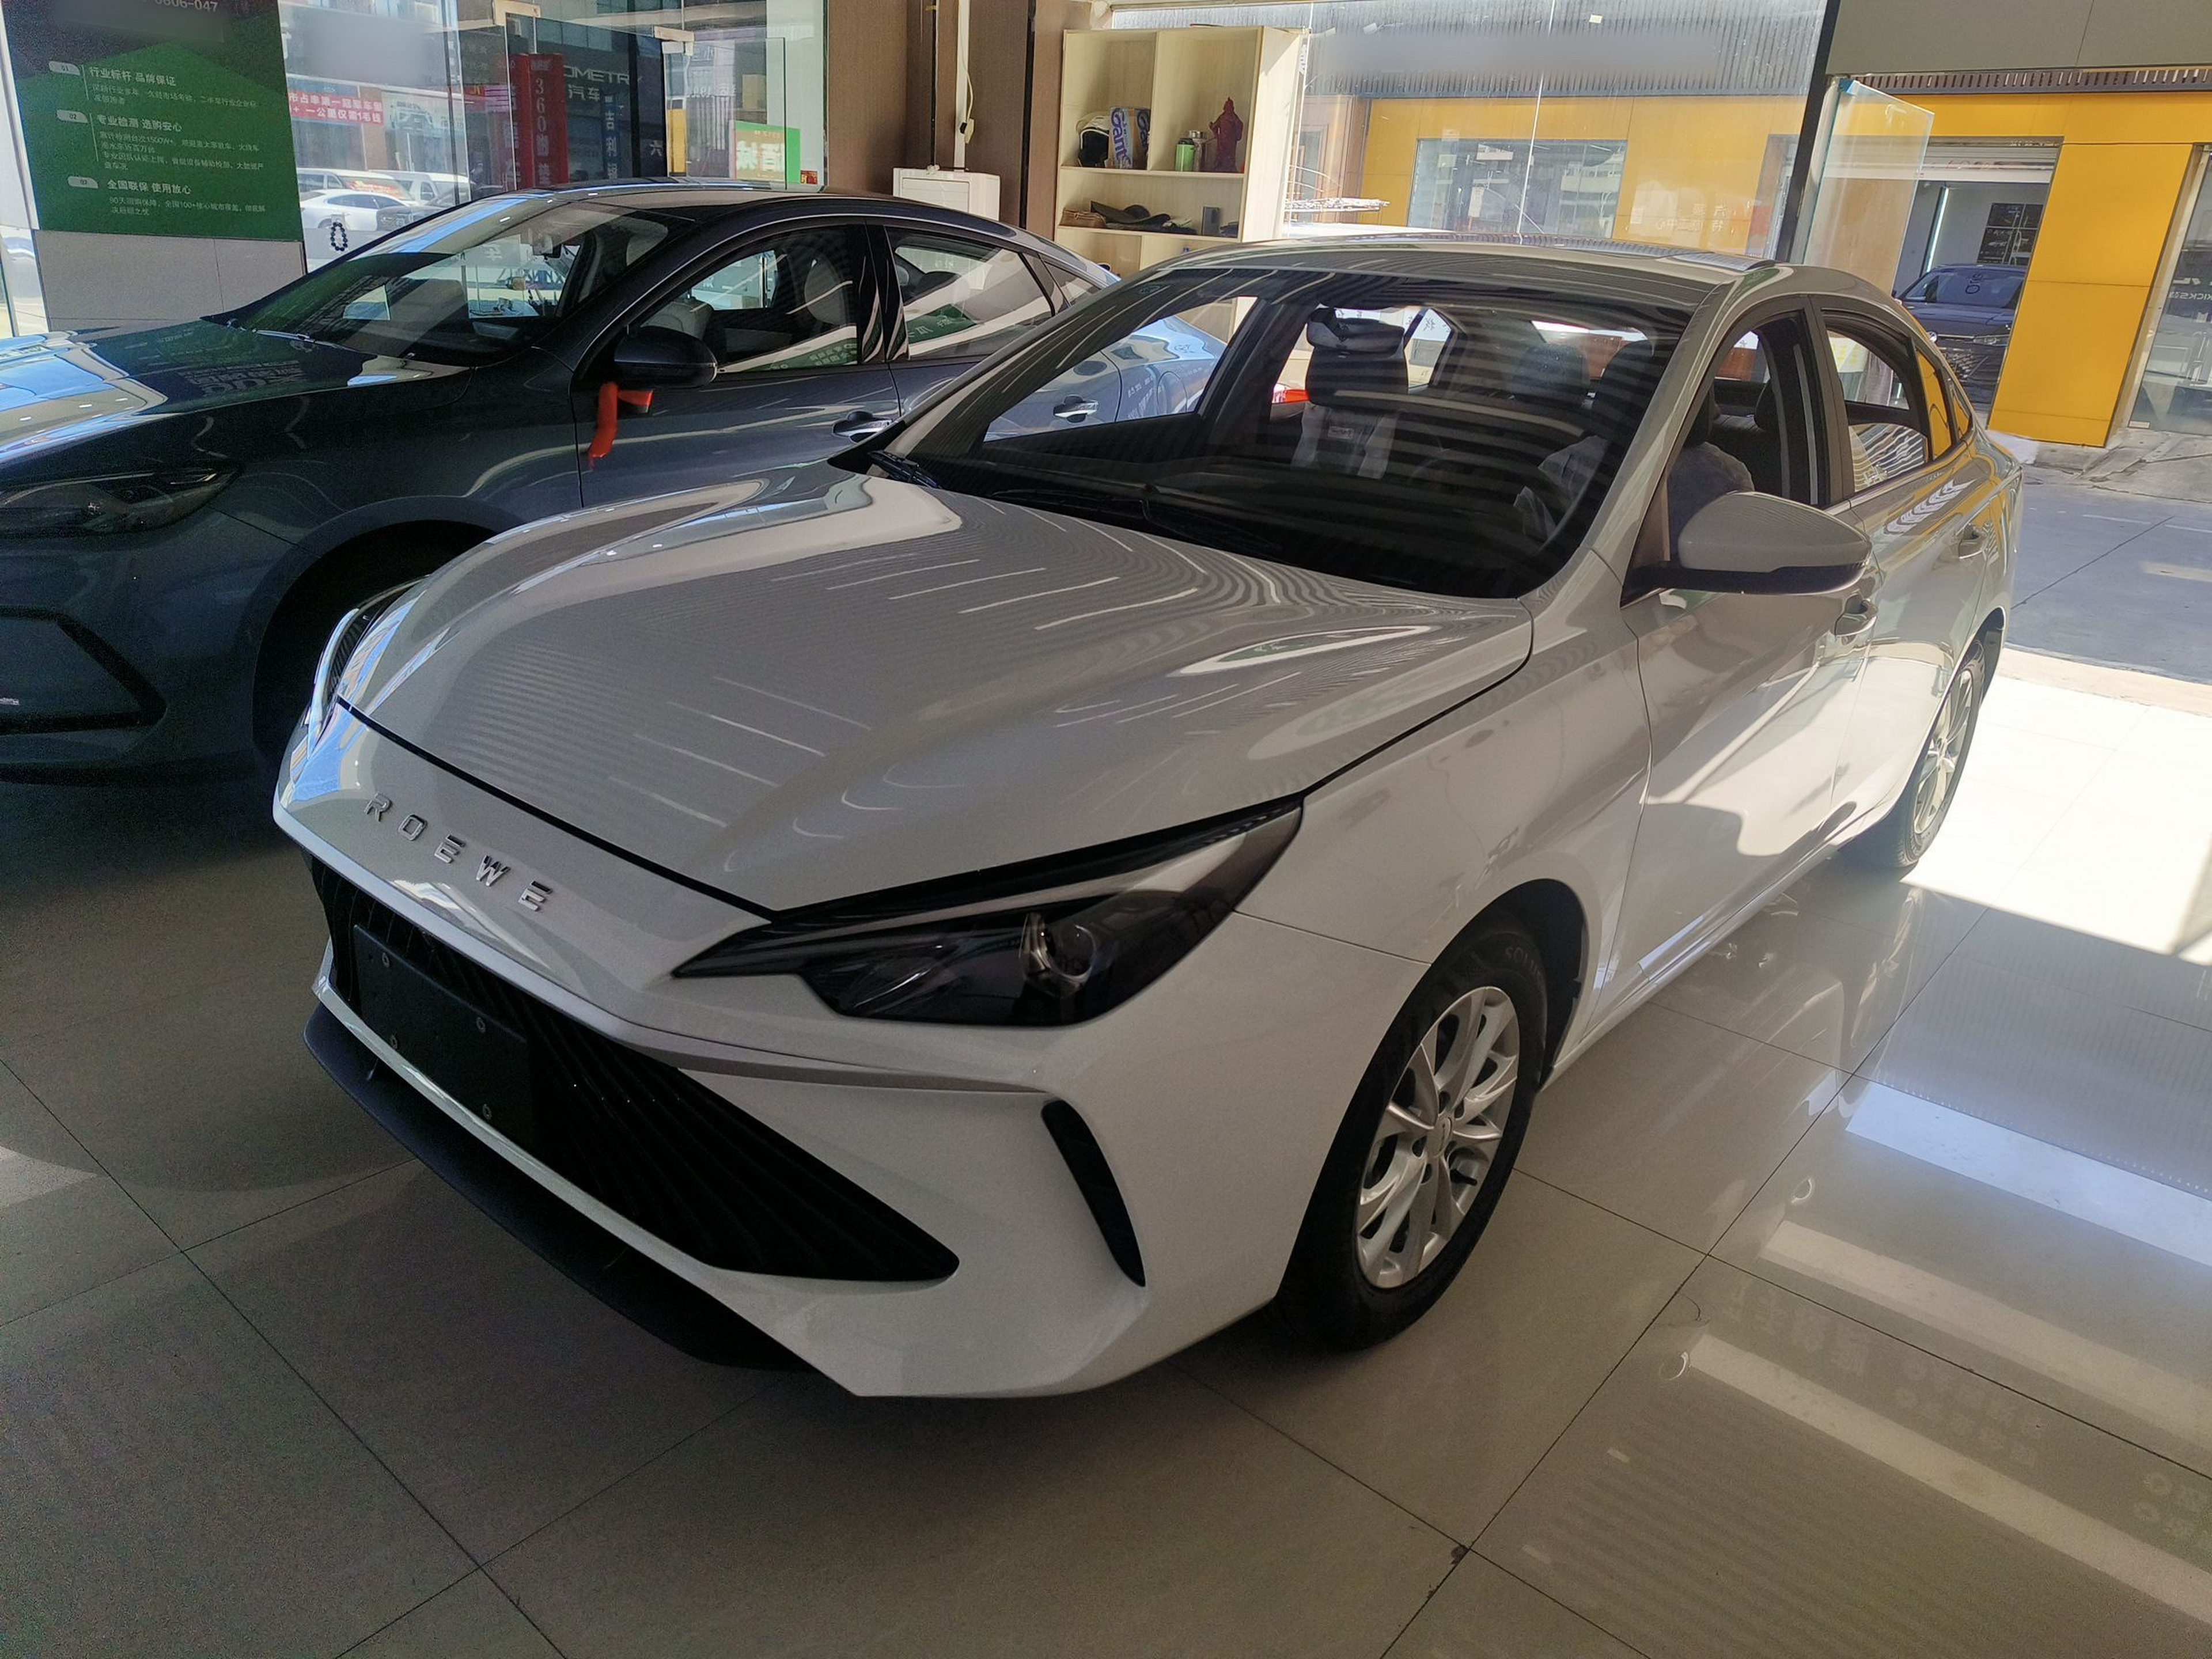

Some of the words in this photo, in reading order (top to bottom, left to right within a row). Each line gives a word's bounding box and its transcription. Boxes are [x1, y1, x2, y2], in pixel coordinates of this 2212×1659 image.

[107, 179, 149, 191] 全国联保
[151, 183, 192, 195] 使用放心
[363, 792, 553, 912] ROEWE
